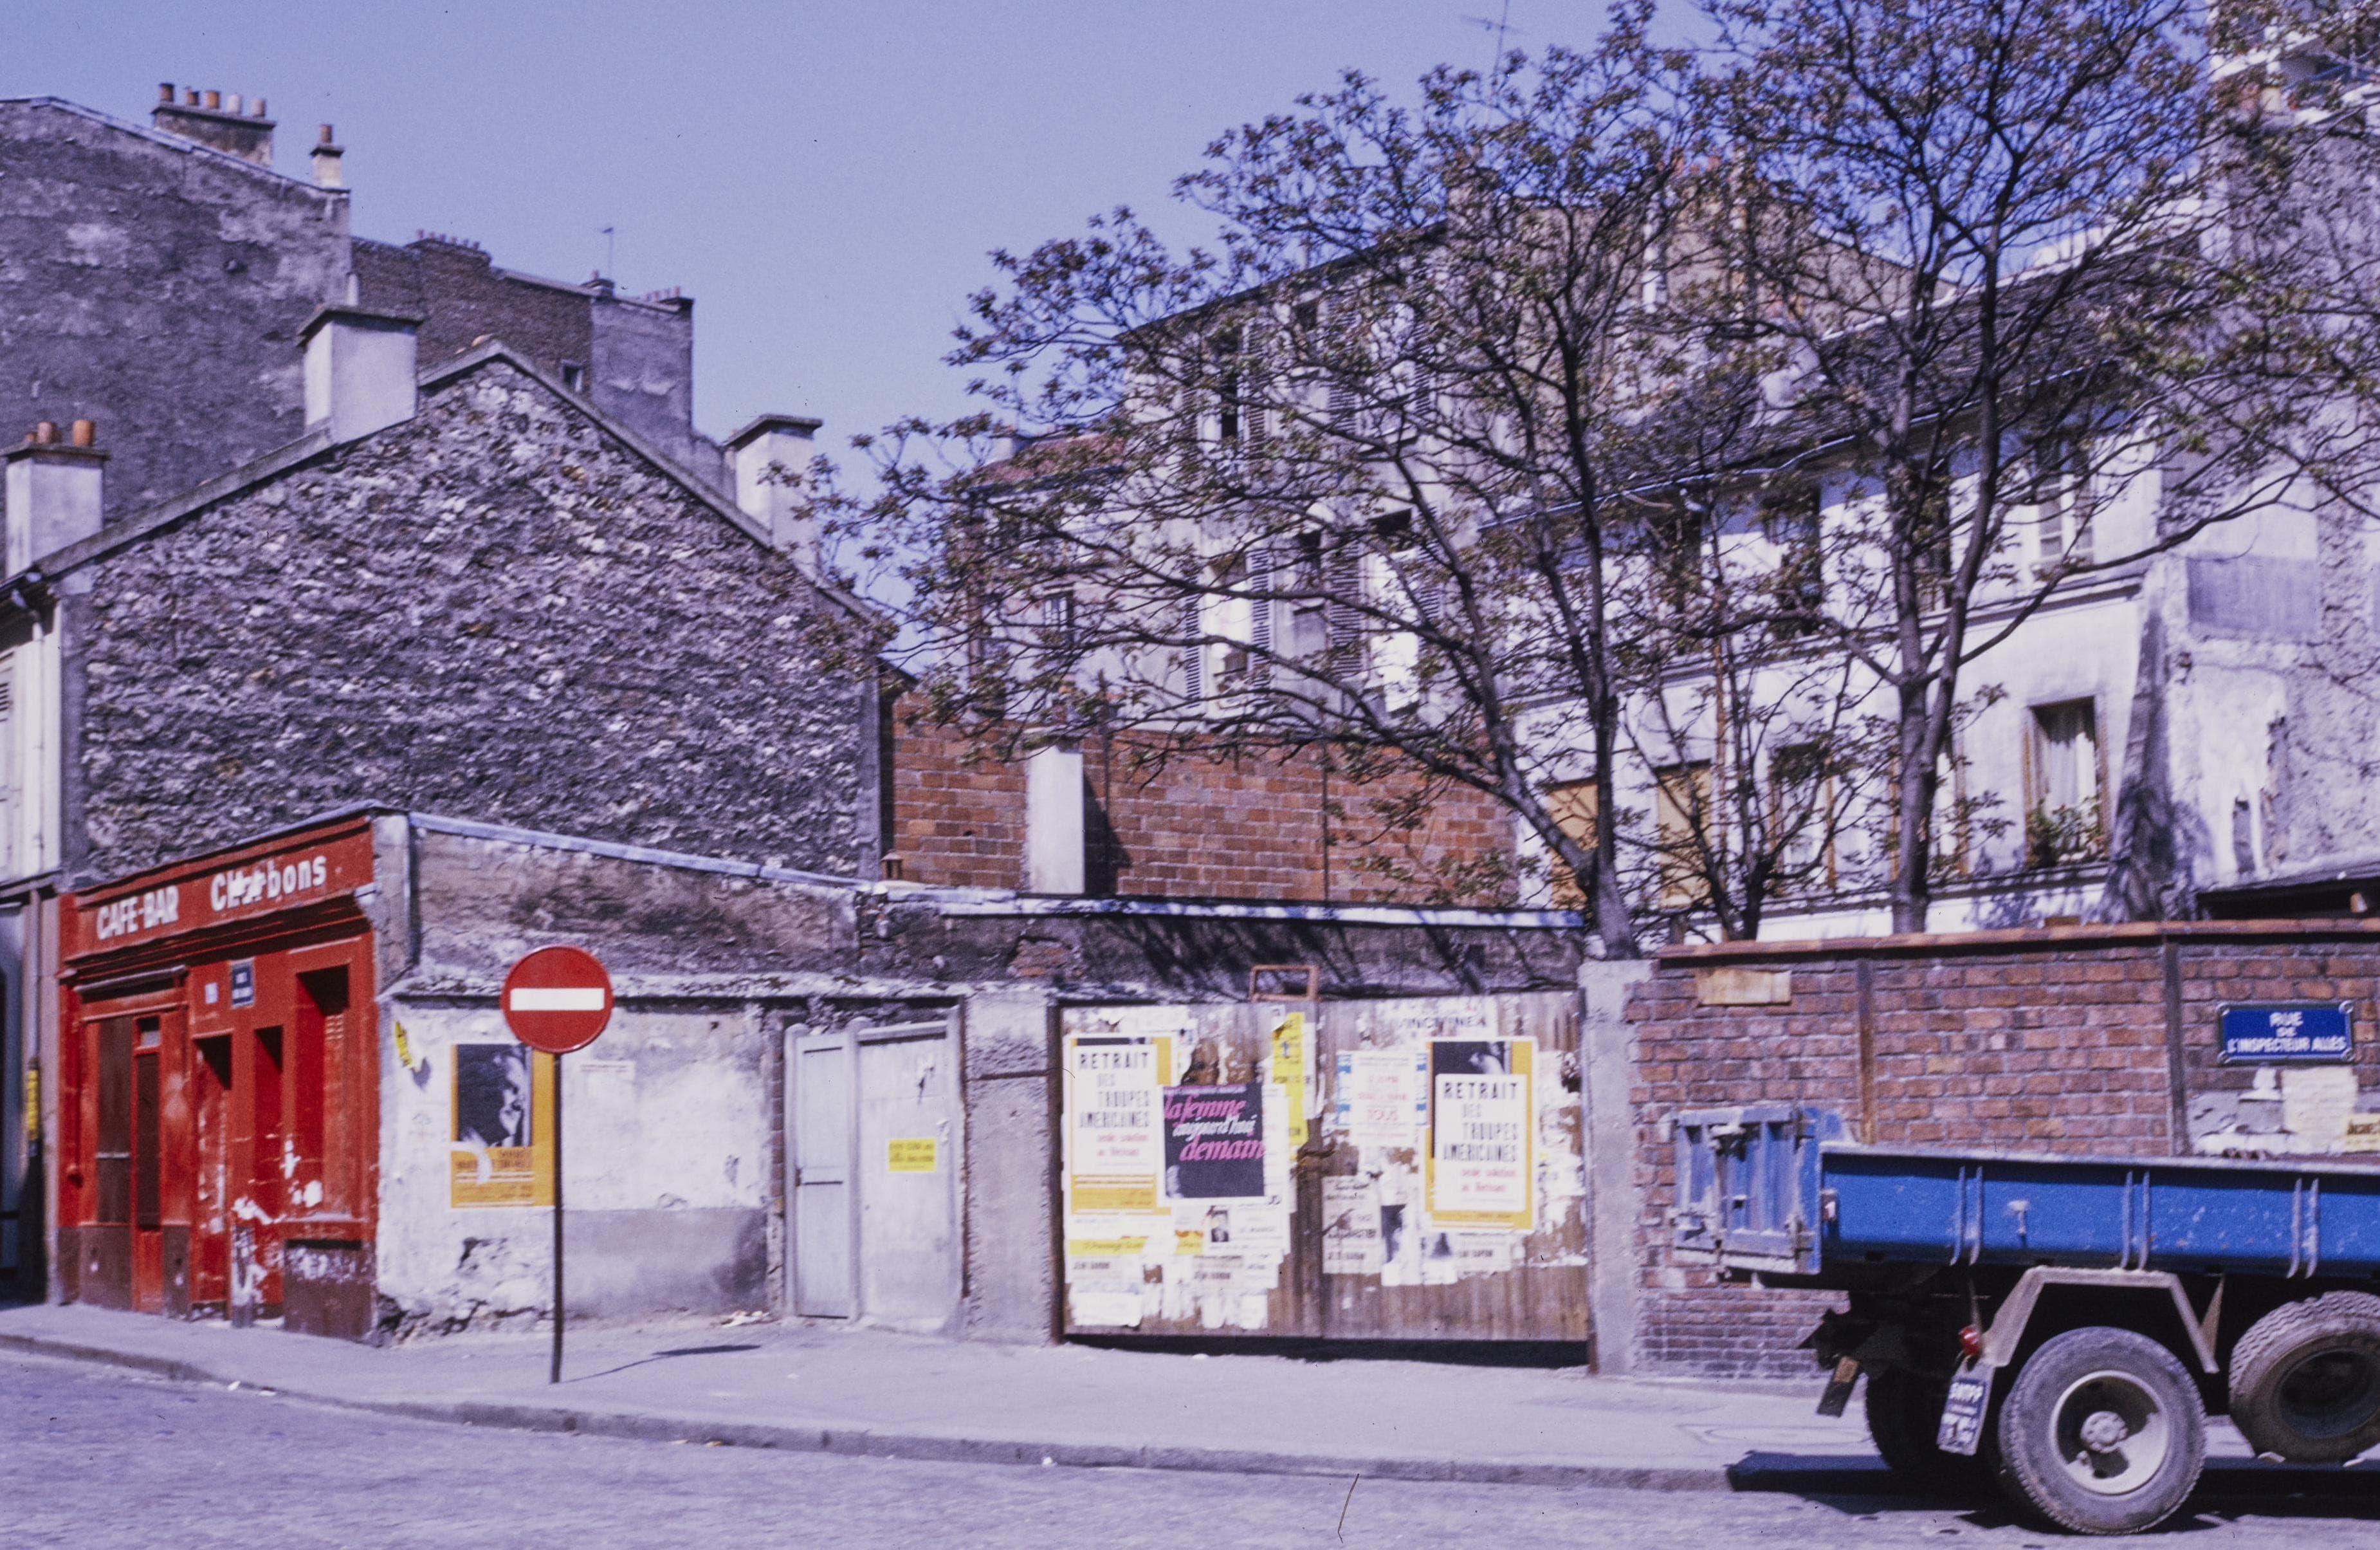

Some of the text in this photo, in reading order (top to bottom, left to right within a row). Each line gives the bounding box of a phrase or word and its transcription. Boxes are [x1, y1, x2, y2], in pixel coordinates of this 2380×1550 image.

[2269, 1011, 2303, 1028] RUE
[2276, 1026, 2296, 1037] DE
[2228, 1037, 2311, 1053] L'INSPECTEUR
[1080, 1052, 1149, 1069] RETRAIT
[1098, 1091, 1149, 1107] TROUPES
[1444, 1082, 1517, 1100] RETRAIT
[1164, 1093, 1247, 1128] la femme
[1463, 1123, 1517, 1141] TROUPES
[1180, 1130, 1265, 1161] demain
